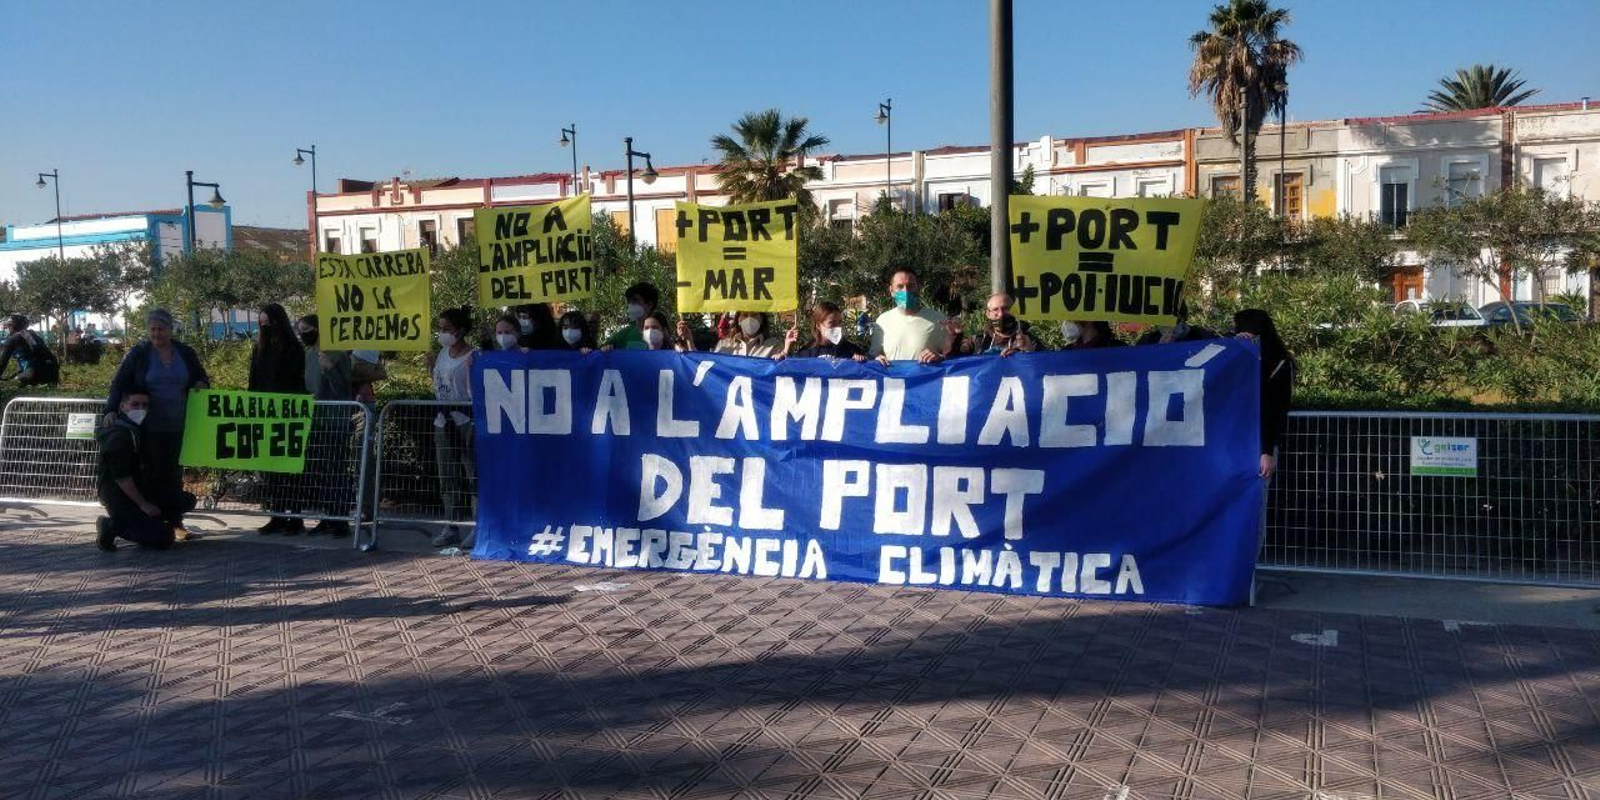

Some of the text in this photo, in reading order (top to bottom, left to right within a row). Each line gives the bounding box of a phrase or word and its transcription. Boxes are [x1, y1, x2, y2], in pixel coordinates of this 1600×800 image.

[495, 206, 567, 240] NO A
[320, 252, 425, 279] ESTA CARRERA
[334, 283, 396, 313] NO LA
[491, 267, 591, 299] DEL PORT
[703, 267, 774, 300] MAR
[330, 313, 421, 344] PERDEMOS
[483, 344, 1226, 447] NO A L'AMPLIACIÓ
[216, 422, 304, 460] COP 26
[637, 453, 1045, 540] DEL PORT
[879, 543, 1145, 595] CLIMÀTICA
